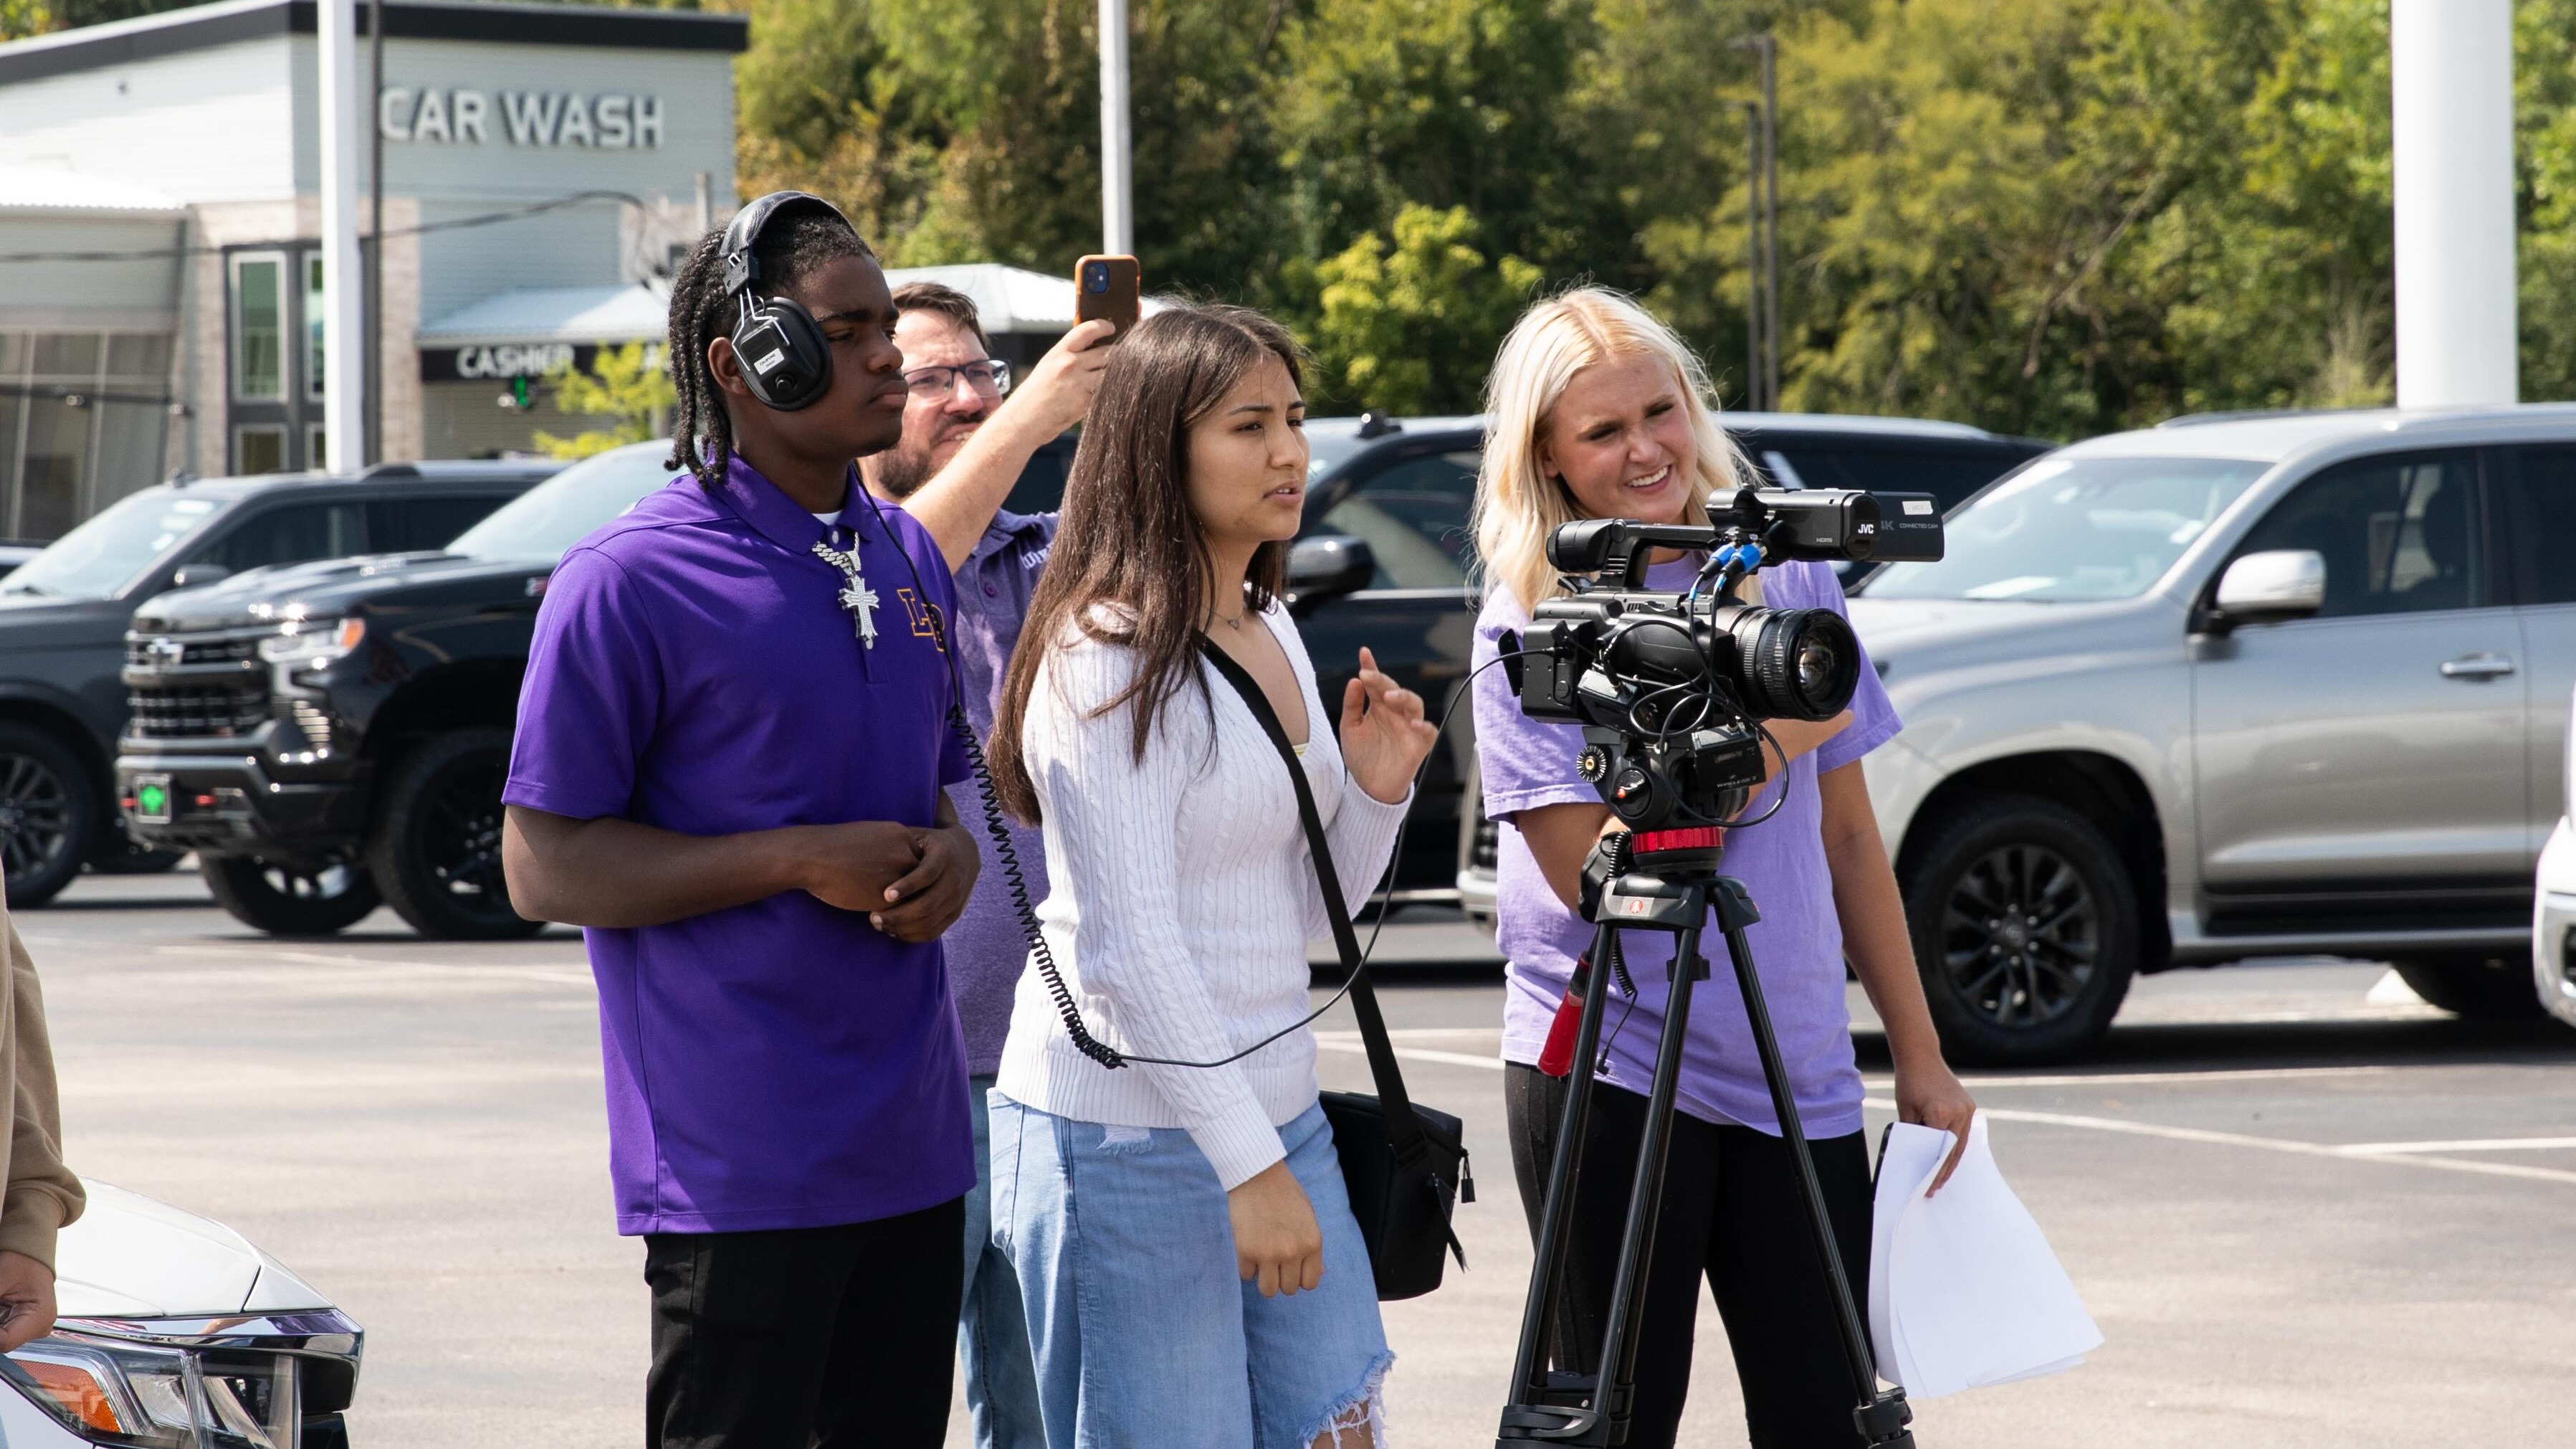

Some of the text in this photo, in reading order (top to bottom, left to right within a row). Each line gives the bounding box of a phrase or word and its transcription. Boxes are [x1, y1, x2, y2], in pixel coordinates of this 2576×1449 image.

[381, 87, 666, 150] CAR WASH
[1858, 524, 1874, 534] JVC
